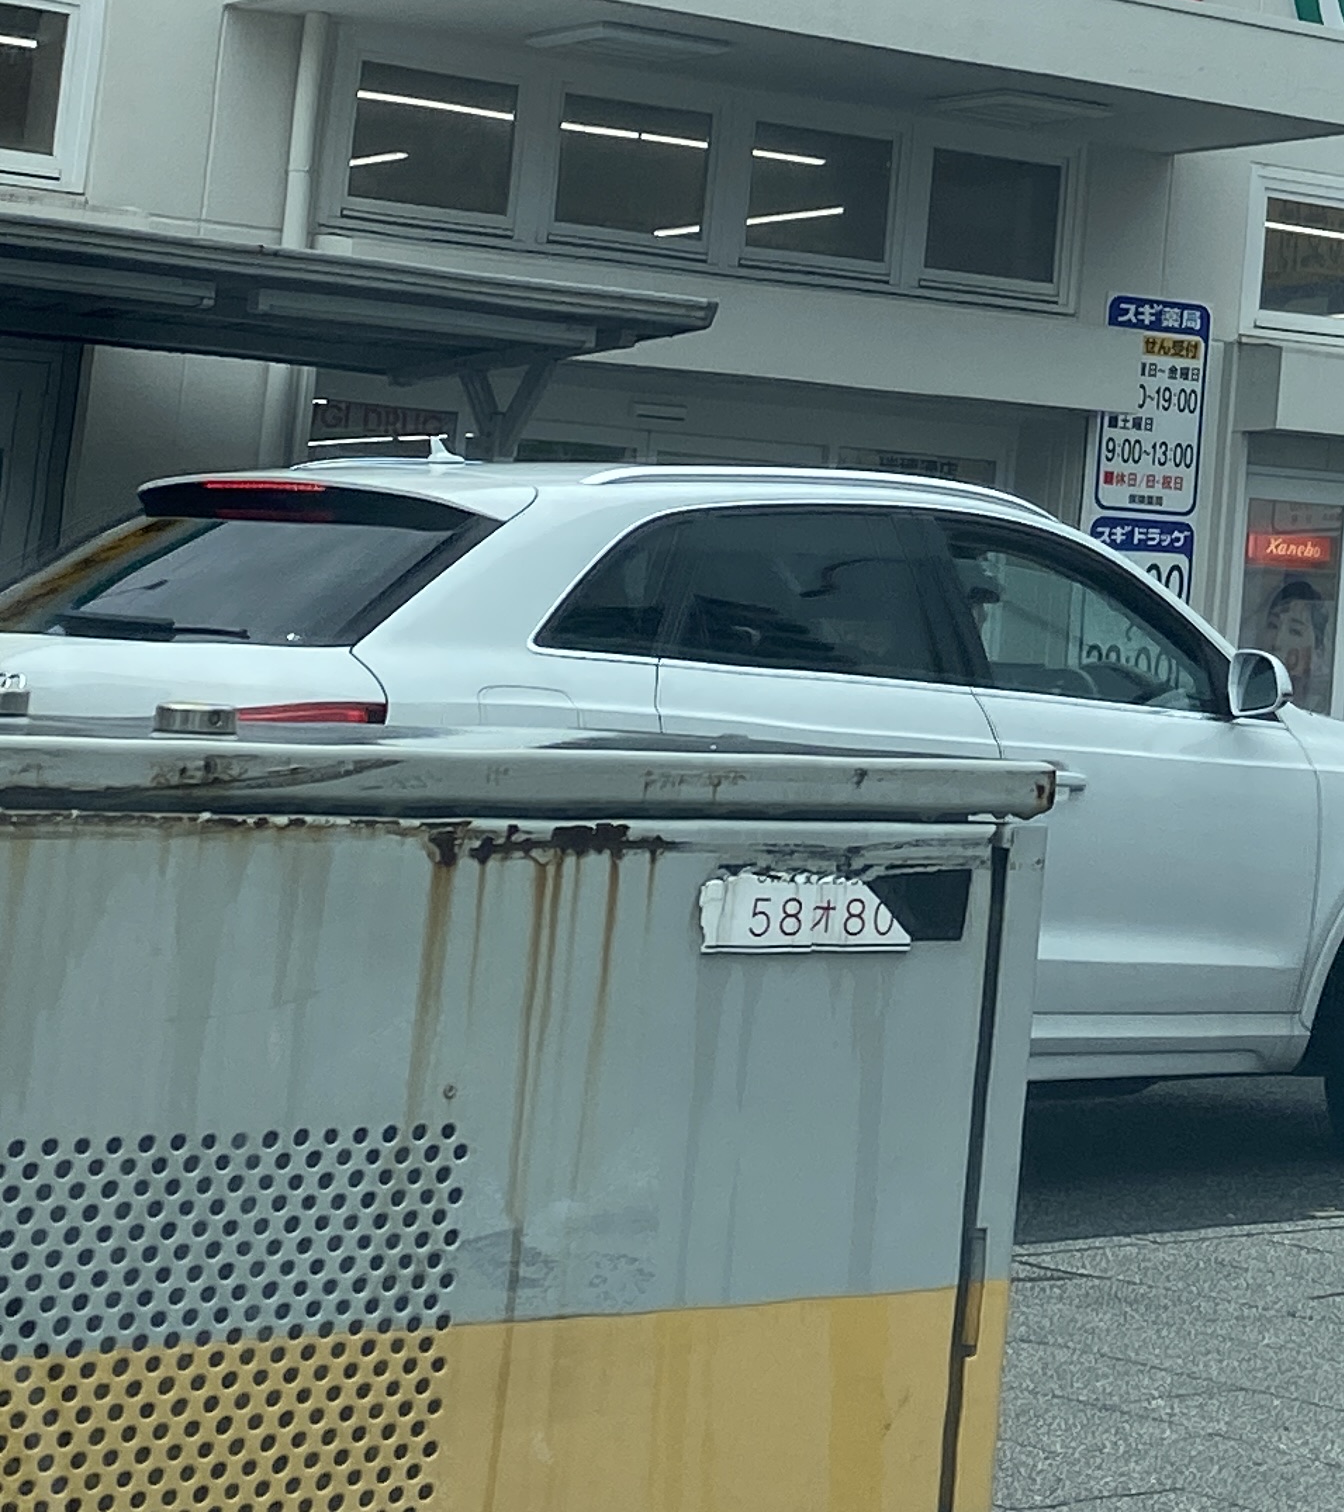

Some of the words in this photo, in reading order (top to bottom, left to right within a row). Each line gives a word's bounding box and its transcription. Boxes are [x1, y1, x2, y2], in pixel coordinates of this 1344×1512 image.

[1117, 303, 1202, 330] スギ薬局
[1265, 536, 1322, 560] Kanebo
